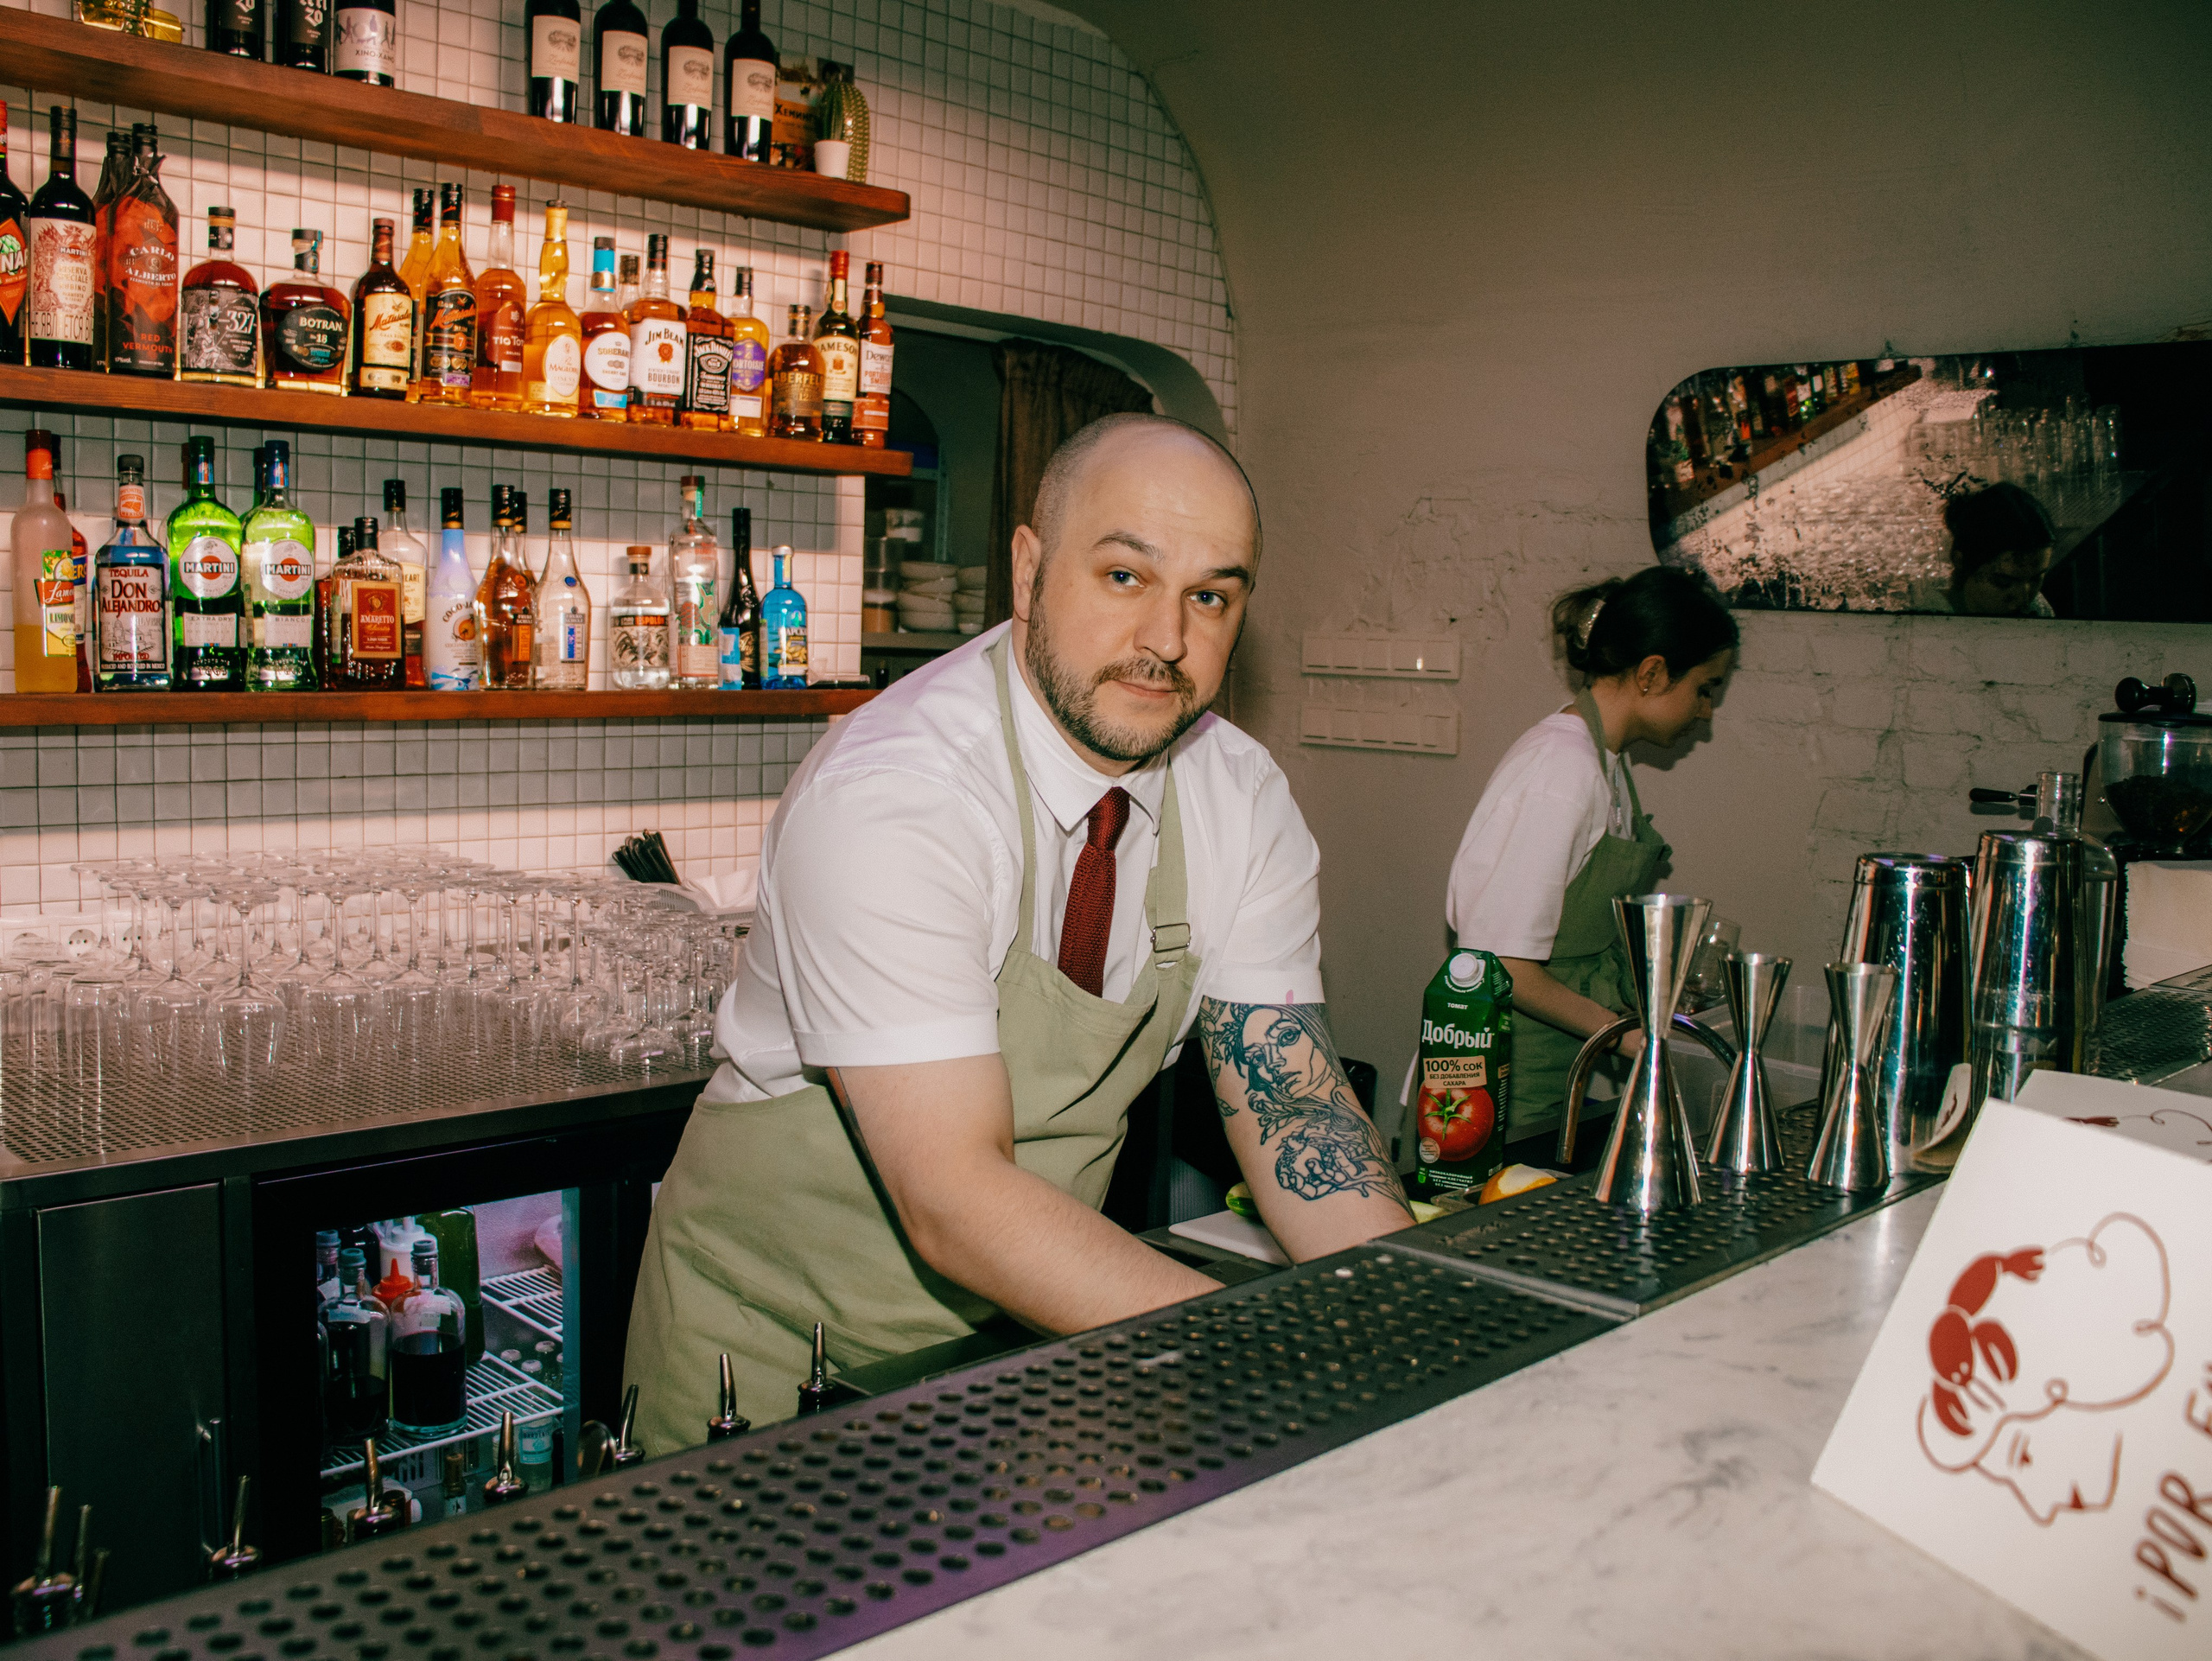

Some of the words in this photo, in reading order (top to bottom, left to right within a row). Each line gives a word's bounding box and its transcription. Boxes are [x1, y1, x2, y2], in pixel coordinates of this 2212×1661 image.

[125, 266, 176, 283] ALBERTO
[41, 311, 84, 340] ЯВЛЕТСЯ
[226, 309, 256, 334] 327
[299, 316, 343, 333] BOTRAN
[141, 333, 161, 342] RED
[645, 330, 662, 346] JIM
[123, 342, 173, 354] VERMOUTH
[694, 342, 710, 359] JACK
[647, 372, 680, 385] BOURBON
[108, 568, 149, 578] TEQUILA
[184, 562, 235, 574] MARTINI
[265, 564, 312, 576] MARTINI
[404, 573, 421, 583] EART
[111, 579, 148, 600] DON
[101, 599, 162, 619] ALEJANDRO
[442, 601, 463, 624] COCO
[359, 614, 395, 625] AMARETTO
[112, 652, 150, 661] IMPOTED
[1421, 1019, 1492, 1049] Добрый
[1425, 1060, 1461, 1072] 100%
[1440, 1072, 1481, 1080] ДОБАВЛЕНИЯ
